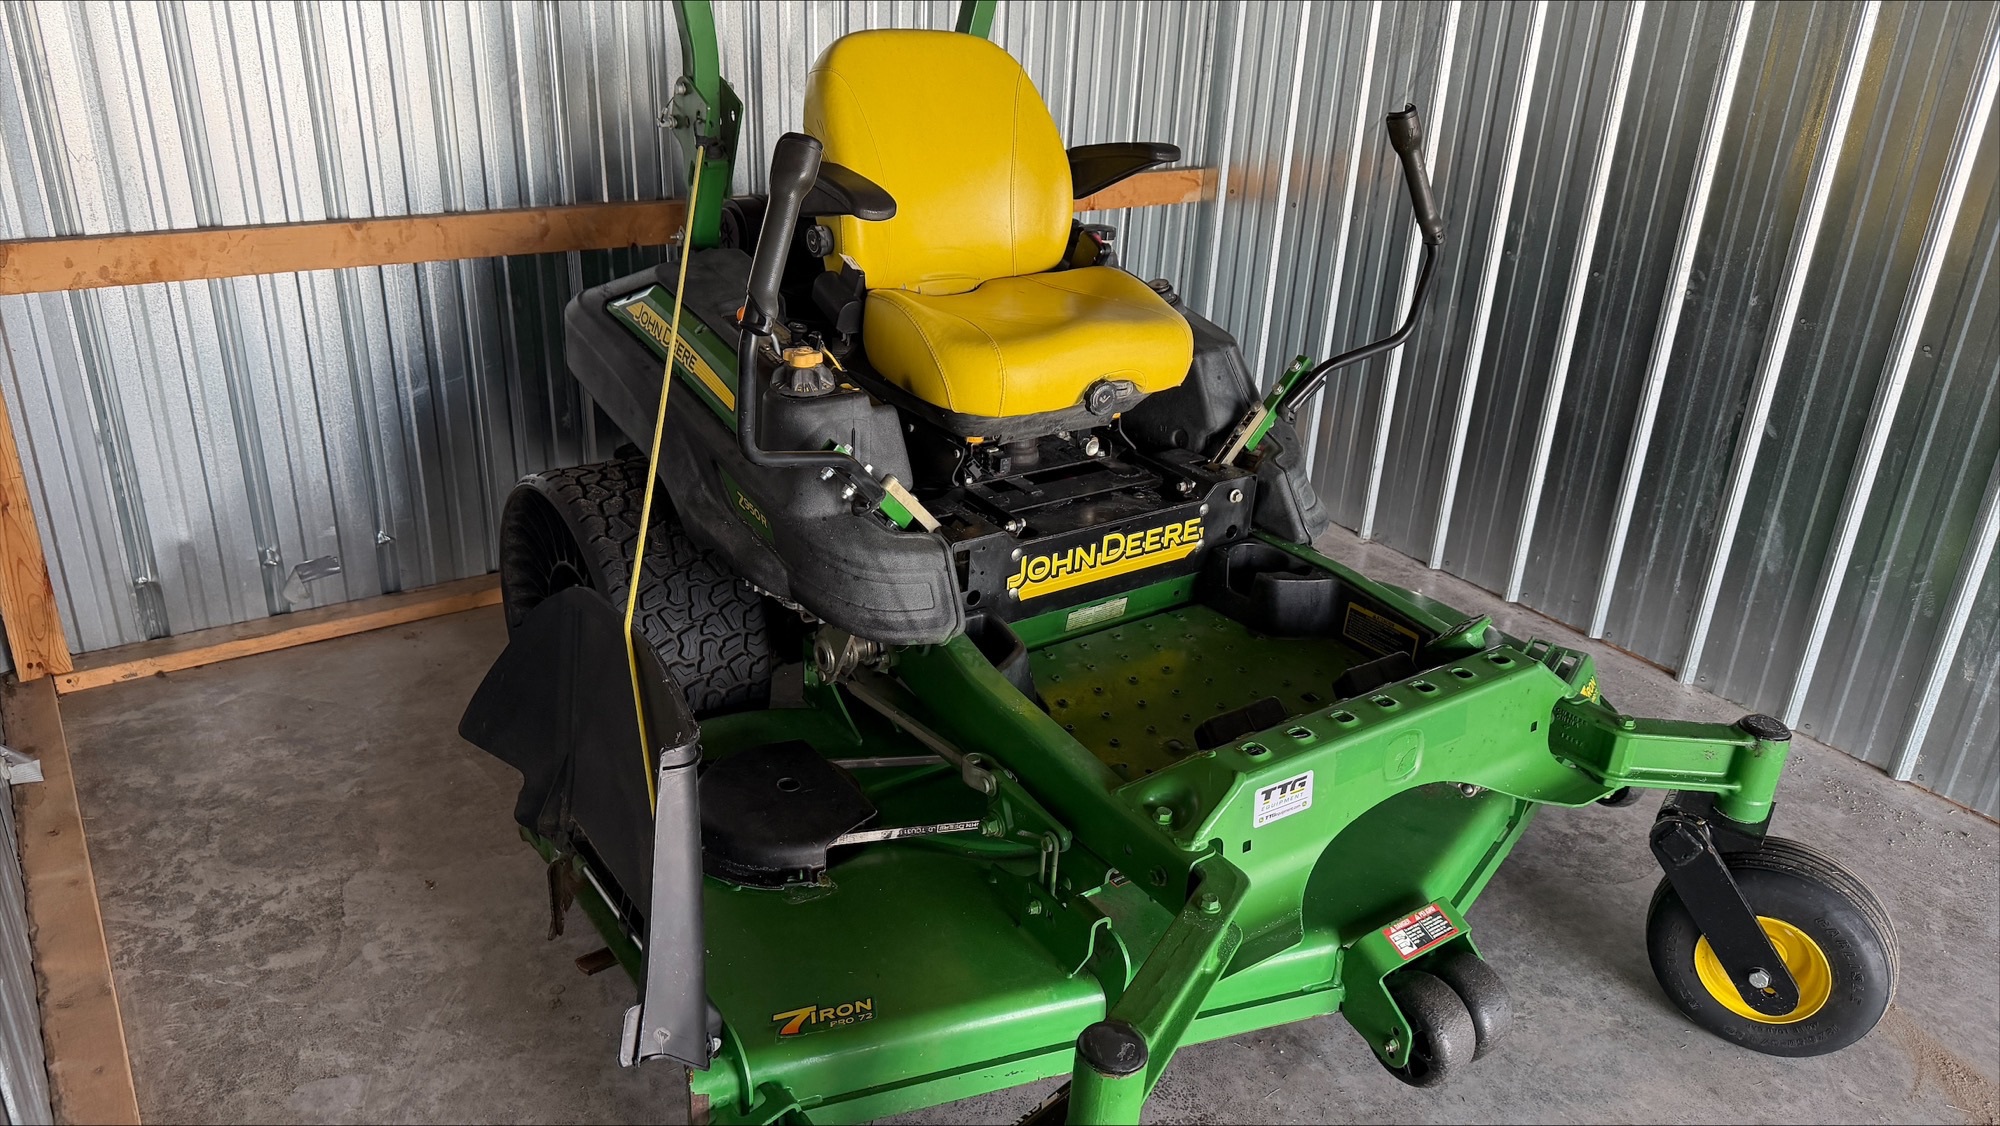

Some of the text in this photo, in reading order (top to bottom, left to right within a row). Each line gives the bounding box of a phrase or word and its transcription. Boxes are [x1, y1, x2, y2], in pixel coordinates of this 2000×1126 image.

[634, 305, 663, 341] JOHN
[1008, 516, 1203, 590] JOHN DEERE
[1260, 775, 1308, 804] TTG
[1261, 792, 1304, 812] EQUIPMENT
[1814, 916, 1866, 1006] CARLISLE
[830, 1013, 873, 1028] PRO 72
